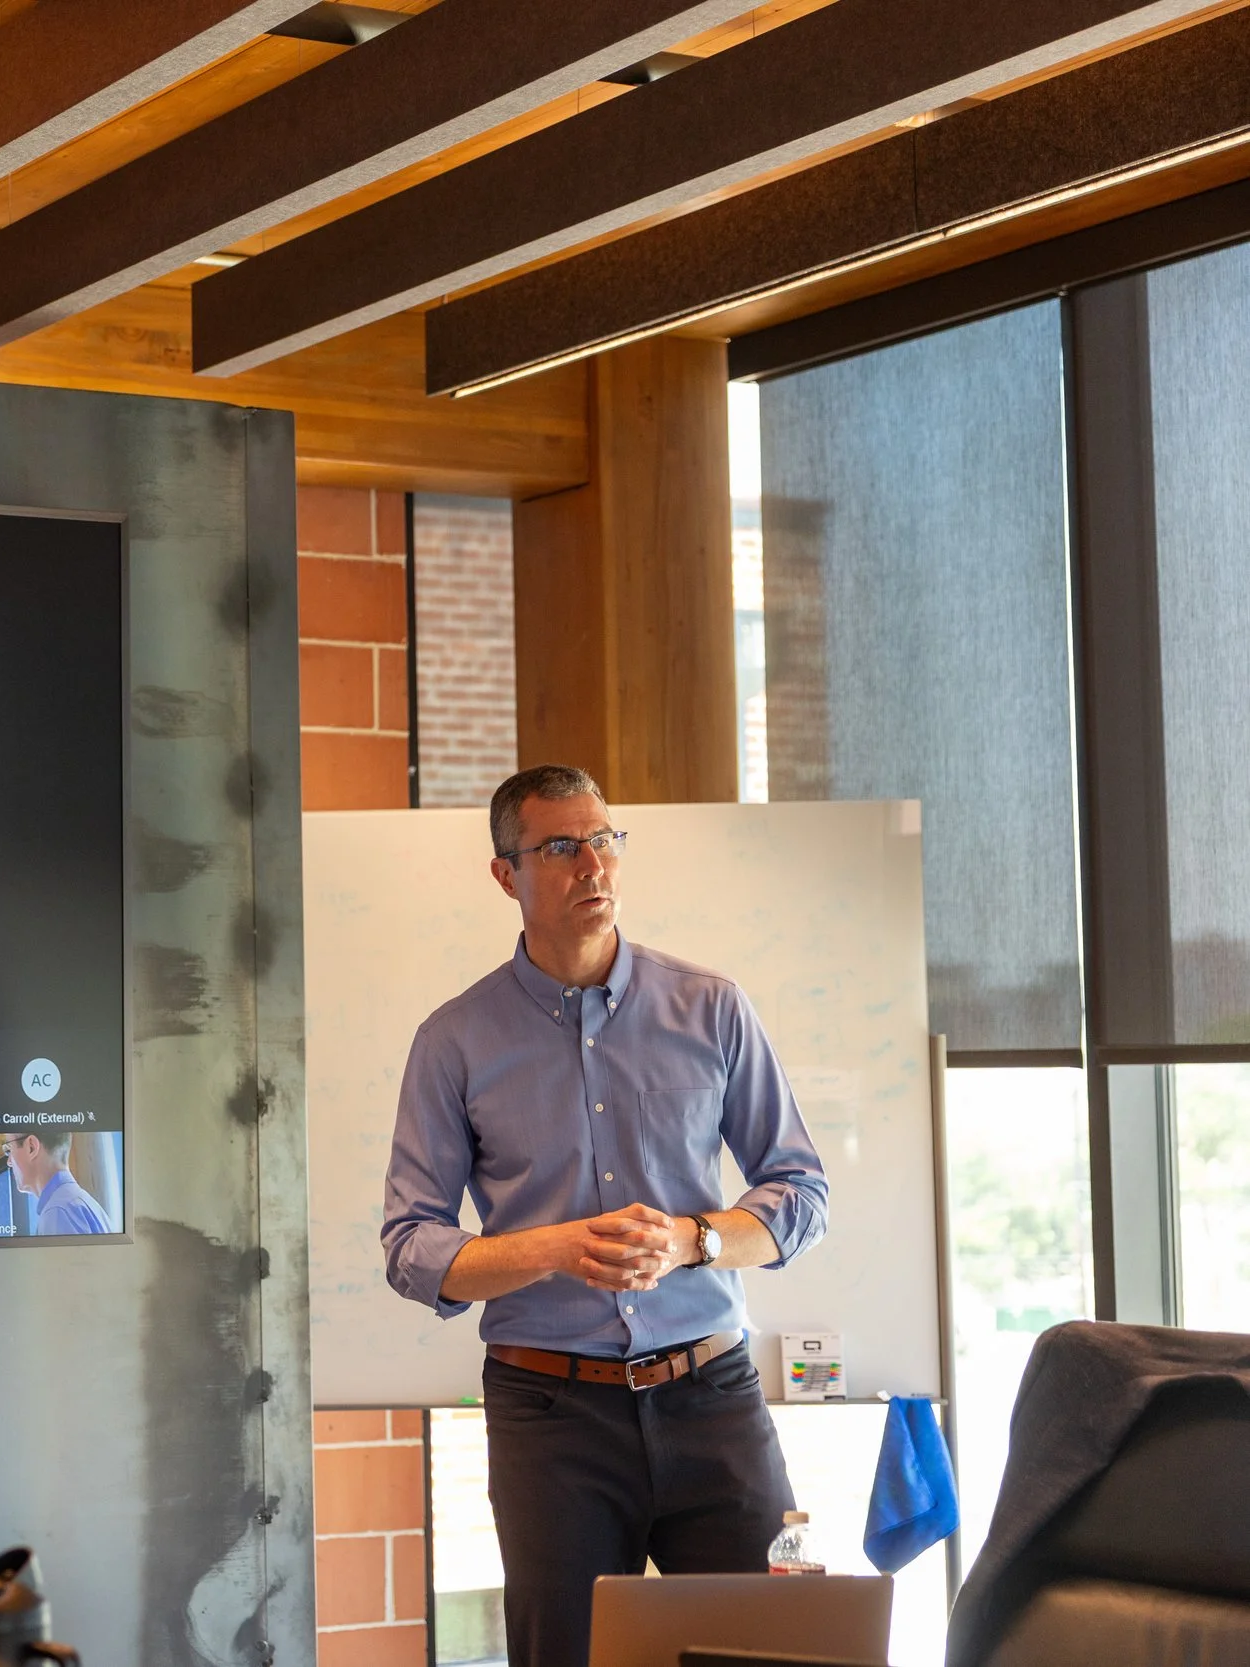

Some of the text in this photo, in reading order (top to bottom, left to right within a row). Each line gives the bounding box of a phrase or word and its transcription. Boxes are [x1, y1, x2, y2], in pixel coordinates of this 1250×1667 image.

[30, 1073, 52, 1087] AC
[2, 1112, 35, 1124] Carroll
[36, 1111, 85, 1126] (External)
